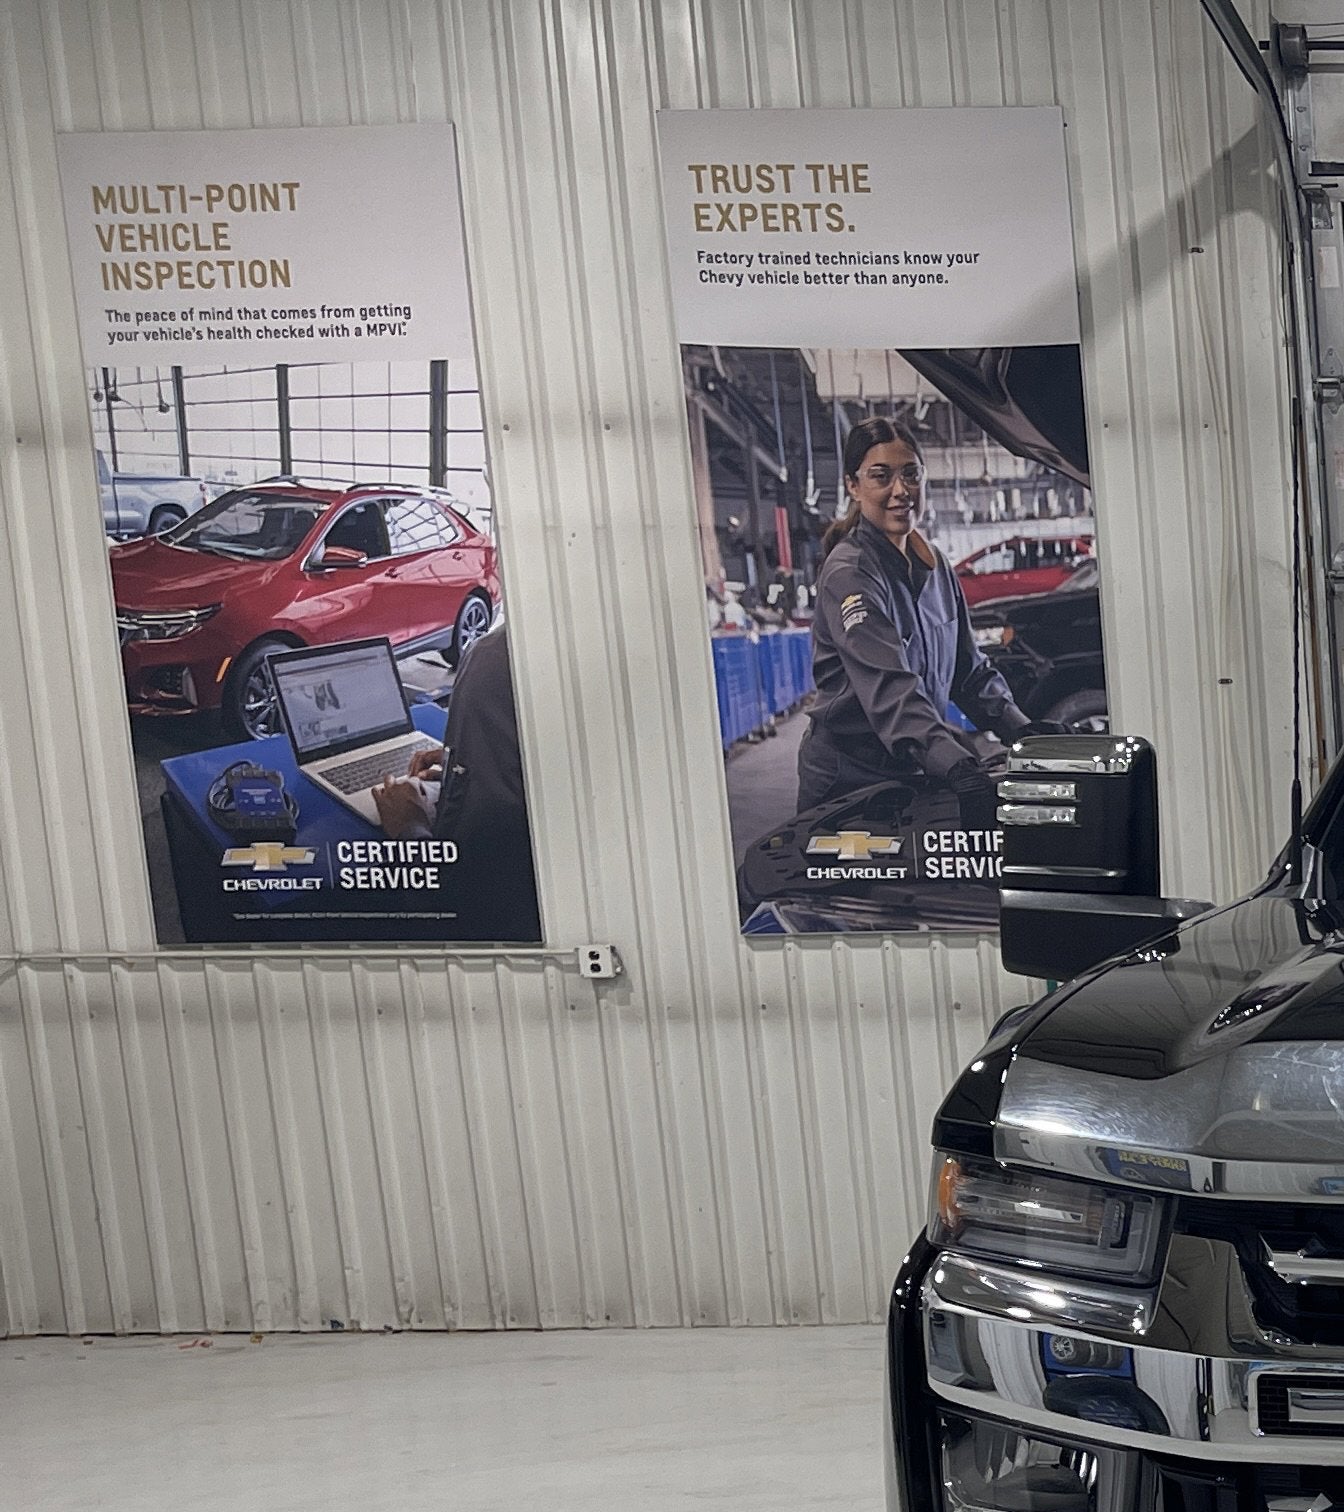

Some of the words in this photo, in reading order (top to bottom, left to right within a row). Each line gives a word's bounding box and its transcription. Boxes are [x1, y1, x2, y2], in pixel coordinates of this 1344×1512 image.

[687, 163, 795, 194] TRUST
[805, 163, 871, 194] THE
[92, 183, 300, 215] MULTI-POINT
[693, 203, 856, 233] EXPERTS.
[95, 222, 231, 252] VEHICLE
[696, 250, 754, 268] Factory
[758, 250, 811, 265] trained
[815, 250, 900, 265] technicians
[903, 250, 942, 264] know
[946, 252, 980, 268] your
[101, 259, 292, 291] INSPECTION
[699, 269, 744, 287] Chevy
[748, 270, 799, 285] vehicle
[803, 270, 850, 285] better
[854, 270, 887, 285] than
[892, 272, 949, 288] anyone.
[105, 308, 131, 323] The
[135, 310, 176, 326] peace
[180, 307, 194, 321] of
[199, 306, 233, 321] mind
[237, 306, 267, 321] that
[271, 307, 317, 320] comes
[320, 304, 355, 319] from
[359, 302, 412, 321] getting
[107, 329, 139, 345] your
[142, 326, 204, 342] vehicle's
[207, 326, 252, 340] health
[255, 324, 314, 339] checked
[318, 323, 350, 338] with
[354, 325, 362, 337] a
[336, 841, 458, 863] CERTIFIED
[222, 877, 324, 891] CHEVROLET
[339, 867, 441, 889] SERVICE
[806, 867, 908, 879] CHEVROLET
